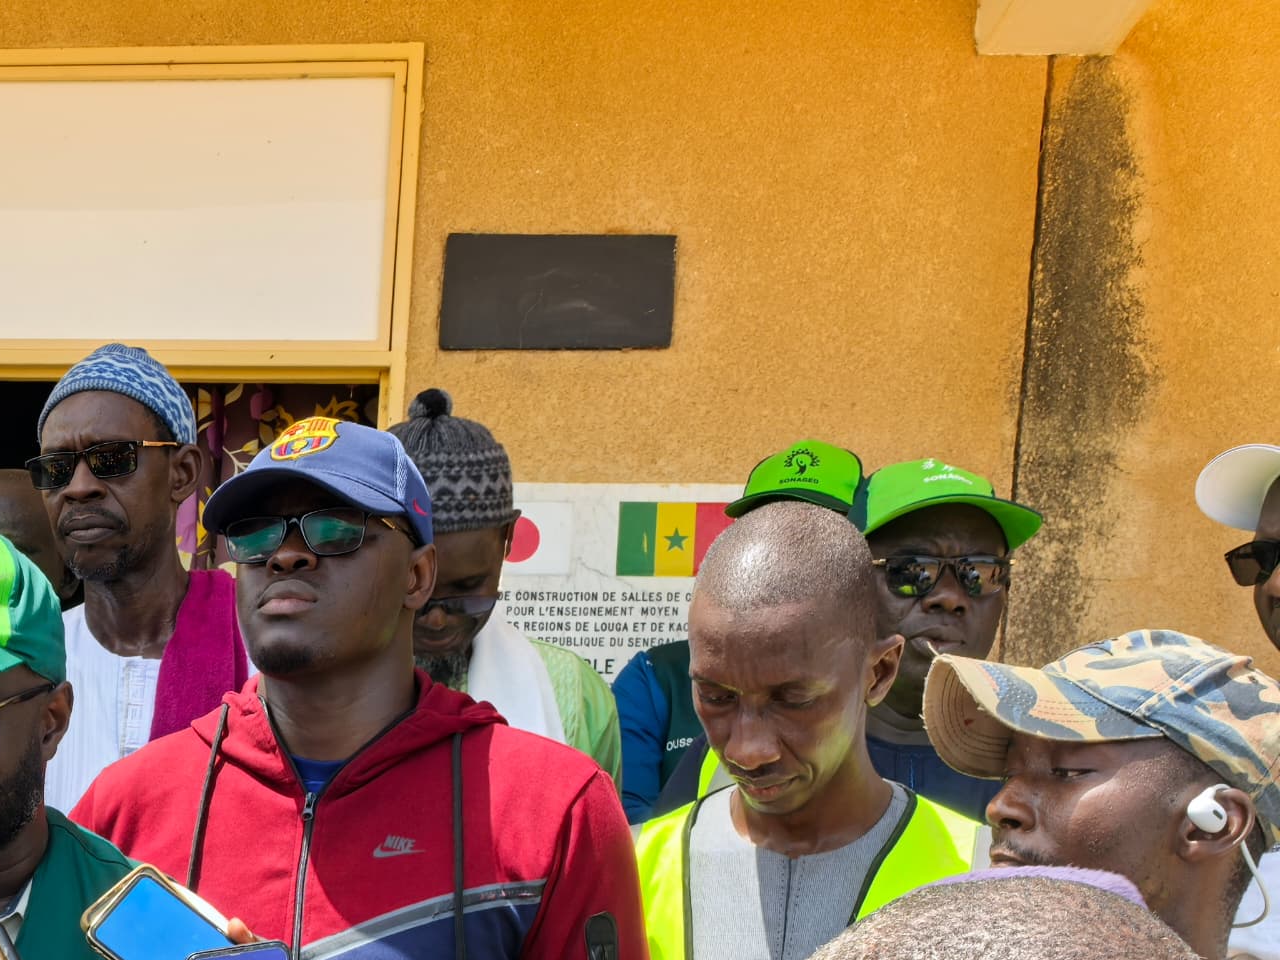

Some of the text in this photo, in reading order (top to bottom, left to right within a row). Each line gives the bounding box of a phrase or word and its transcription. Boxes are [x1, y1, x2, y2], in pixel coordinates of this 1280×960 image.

[497, 591, 511, 601] DE
[515, 591, 598, 602] CONSTRUCTION
[602, 591, 617, 602] DE
[621, 591, 663, 602] SALLES
[666, 592, 681, 602] DE
[506, 606, 679, 616] POUR L'ENSEIGNEMENT MOYEN
[524, 621, 571, 632] REGIONS
[575, 622, 589, 632] DE
[594, 622, 629, 633] LOUGA
[632, 622, 646, 632] ET
[650, 622, 665, 632] DE
[609, 637, 624, 647] DU
[383, 834, 416, 850] NIKE
